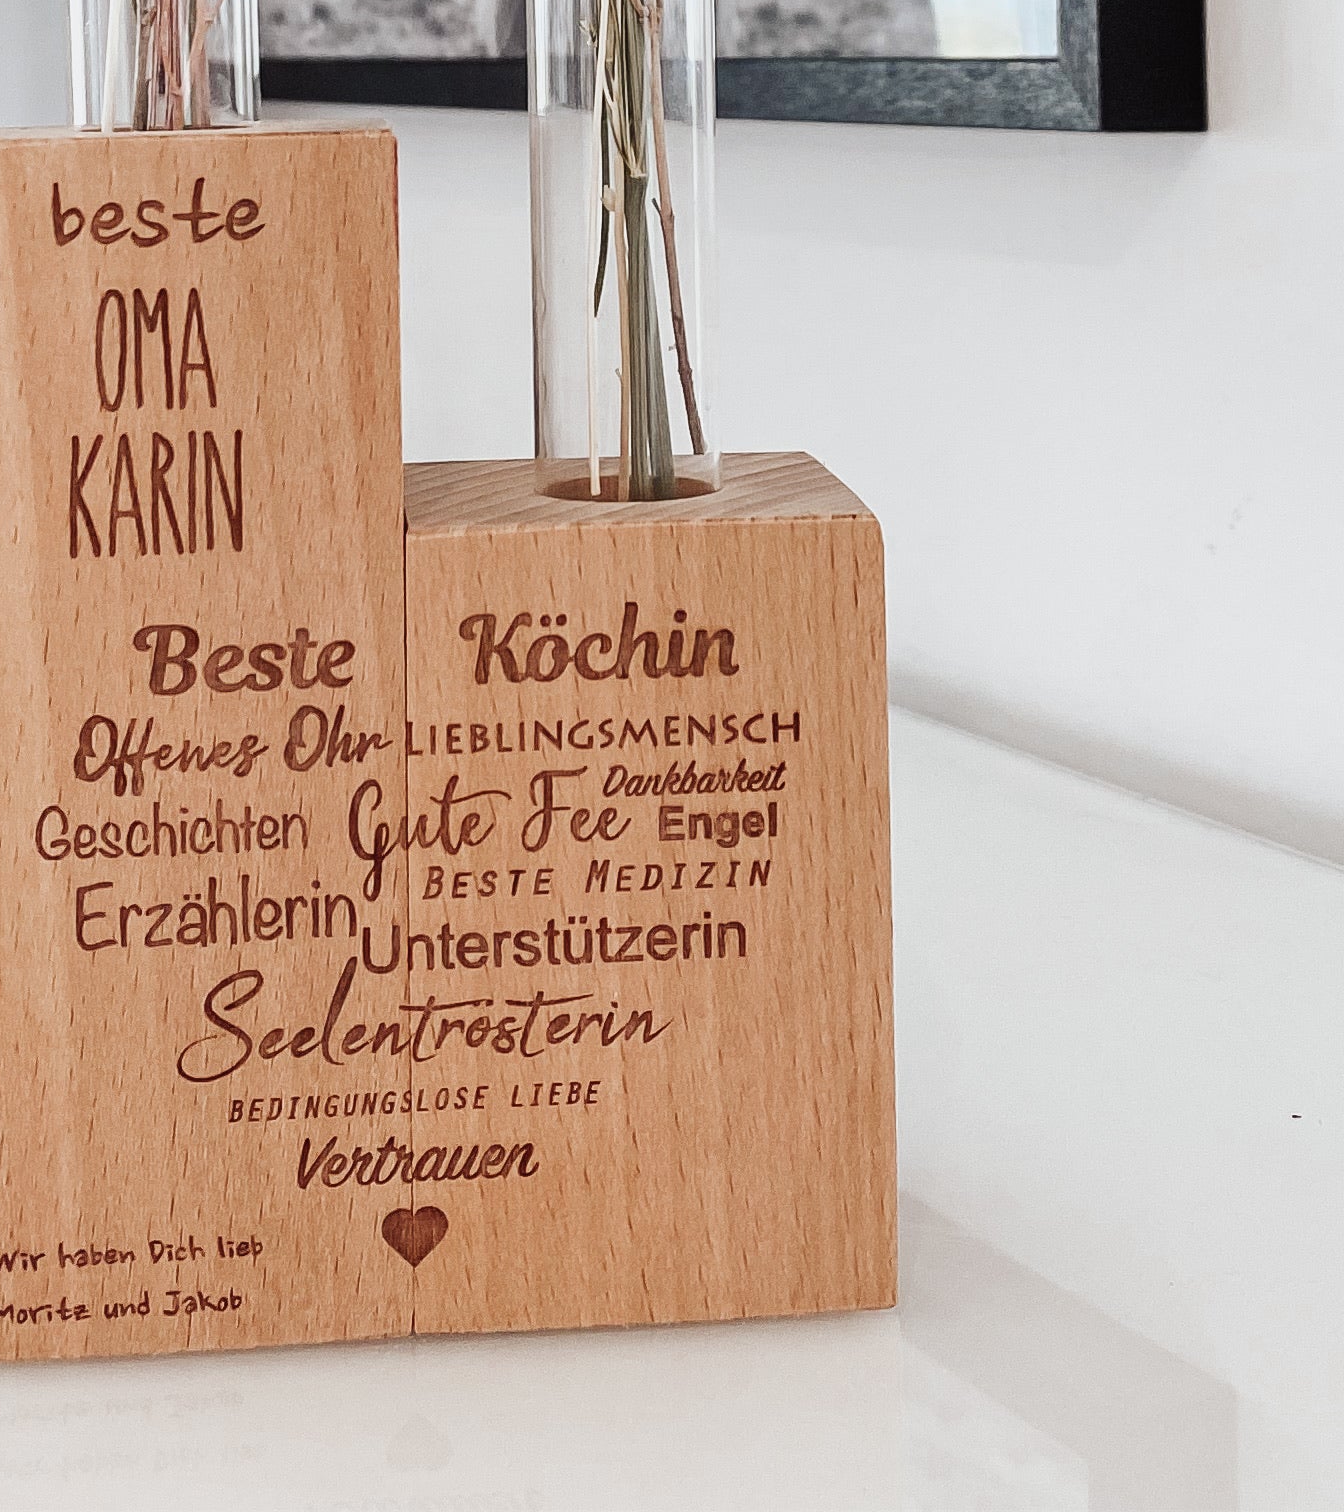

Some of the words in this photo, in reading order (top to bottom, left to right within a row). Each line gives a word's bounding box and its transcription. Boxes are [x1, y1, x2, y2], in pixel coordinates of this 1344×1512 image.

[51, 177, 266, 247] beste
[95, 288, 217, 412] OMA
[69, 429, 243, 559] KARIN
[132, 624, 356, 696] Beste
[459, 602, 739, 685] Köchin
[73, 715, 269, 797] Offenes
[284, 705, 394, 772] Ohr
[406, 712, 801, 756] LIEBLINGSMENSCH
[602, 759, 787, 797] Dankbarkeit
[35, 799, 309, 861] Geschichten
[348, 774, 512, 902] Gute
[521, 765, 632, 853] Fee
[658, 801, 778, 849] Engel
[423, 867, 554, 900] BESTE
[585, 860, 771, 893] MEDIZIN
[75, 874, 358, 951] Erzählerin
[362, 911, 747, 975] Unterstützerin
[228, 1085, 489, 1123] BEDINGUNGSLOSE
[510, 1080, 602, 1109] LIEBE
[296, 1135, 539, 1189] Vertrauen
[58, 1241, 136, 1268] haben
[149, 1235, 205, 1264] Dich
[218, 1234, 264, 1259] lieb
[104, 1291, 150, 1319] und
[163, 1288, 243, 1316] Jakob
